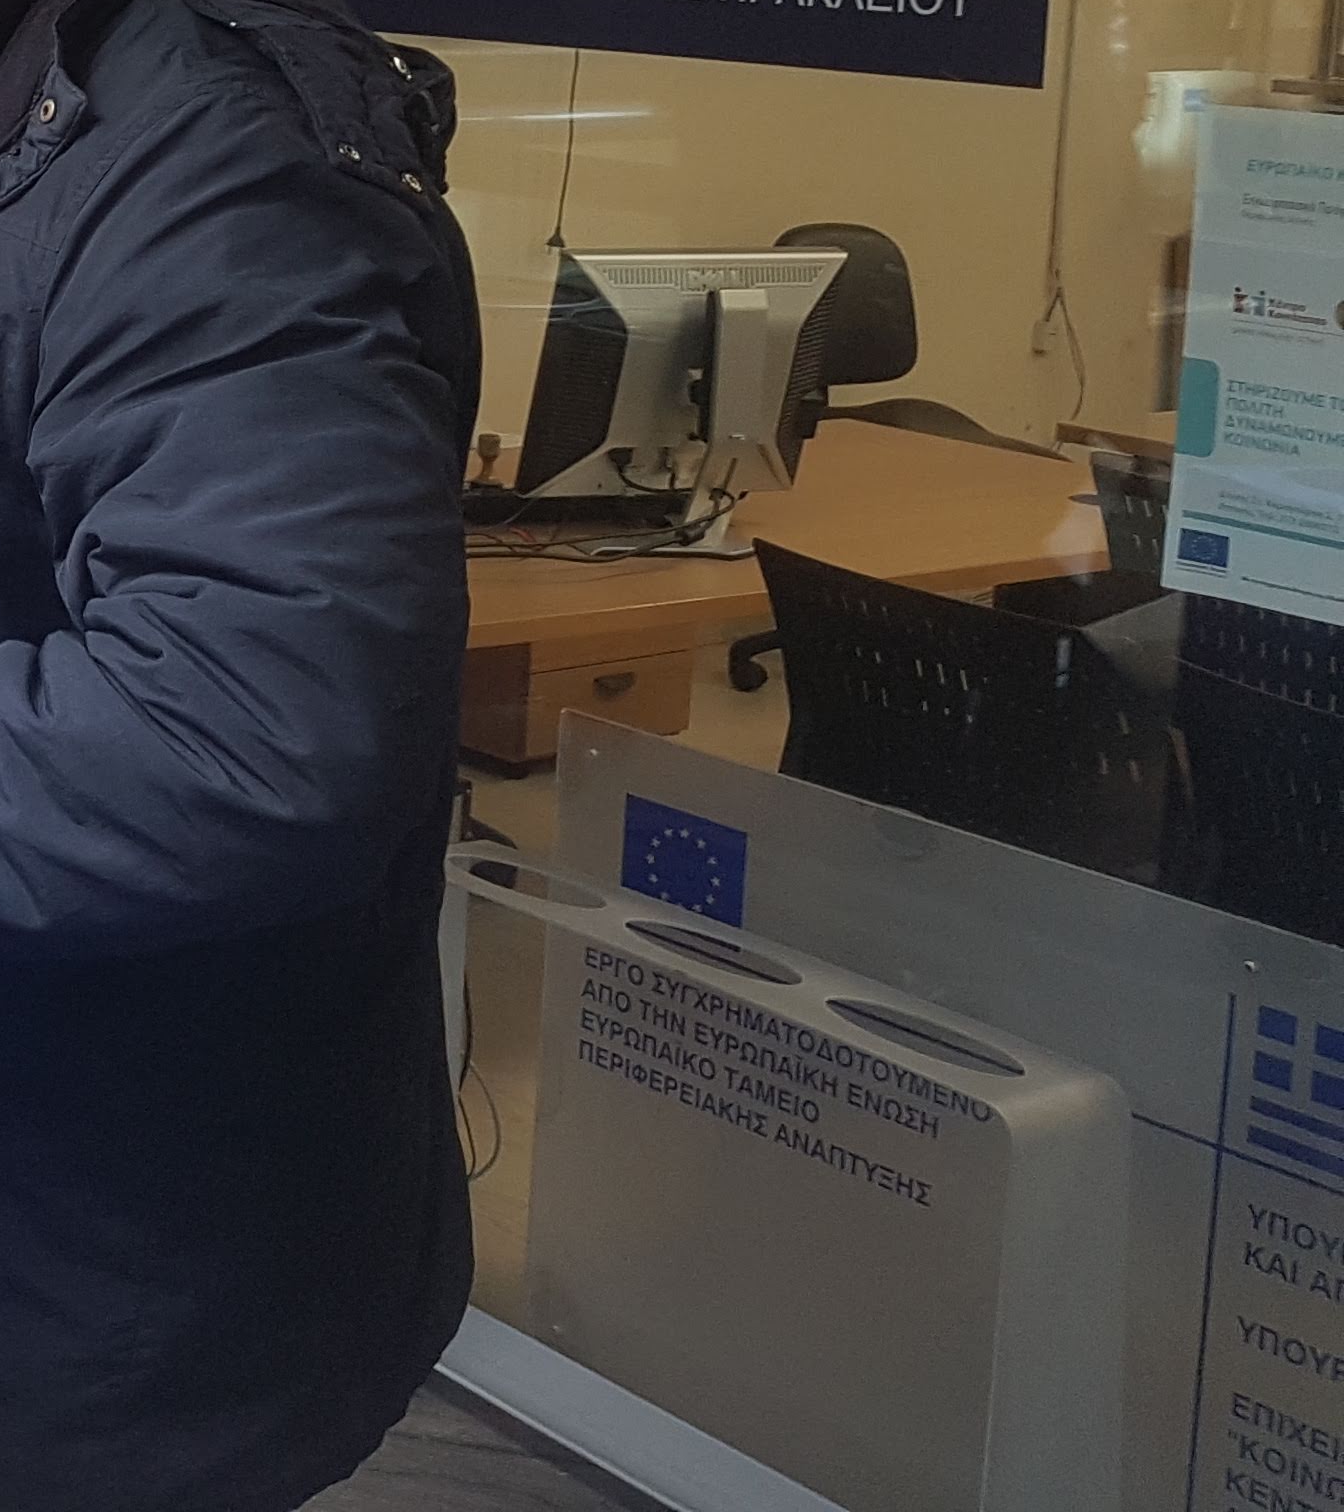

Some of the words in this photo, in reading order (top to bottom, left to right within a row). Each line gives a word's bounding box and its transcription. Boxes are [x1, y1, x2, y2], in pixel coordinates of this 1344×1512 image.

[581, 979, 631, 1014] ΑΠΟ
[639, 998, 687, 1037] ΤΗΝ
[847, 1082, 941, 1139] ΕΝΩΣΗ
[584, 947, 645, 986] ΕΡΓΟ
[651, 971, 996, 1123] ΣΥΓΧΡΗΜΑΤΟΔΟΤΟΥΜΕΝΟ
[579, 1038, 769, 1138] ΠΕΡΙΦΕΡΕΙΑΚΗΣ
[773, 1123, 934, 1208] ΑΝΑΠΤΥΞΗΣ
[723, 1065, 820, 1125] ΤΑΜΕΙΟ
[1243, 1241, 1298, 1285] ΚΑΙ
[1247, 1203, 1344, 1266] ΥΠΟΥ
[1231, 1390, 1344, 1466] ΕΠΙΧΕΙ
